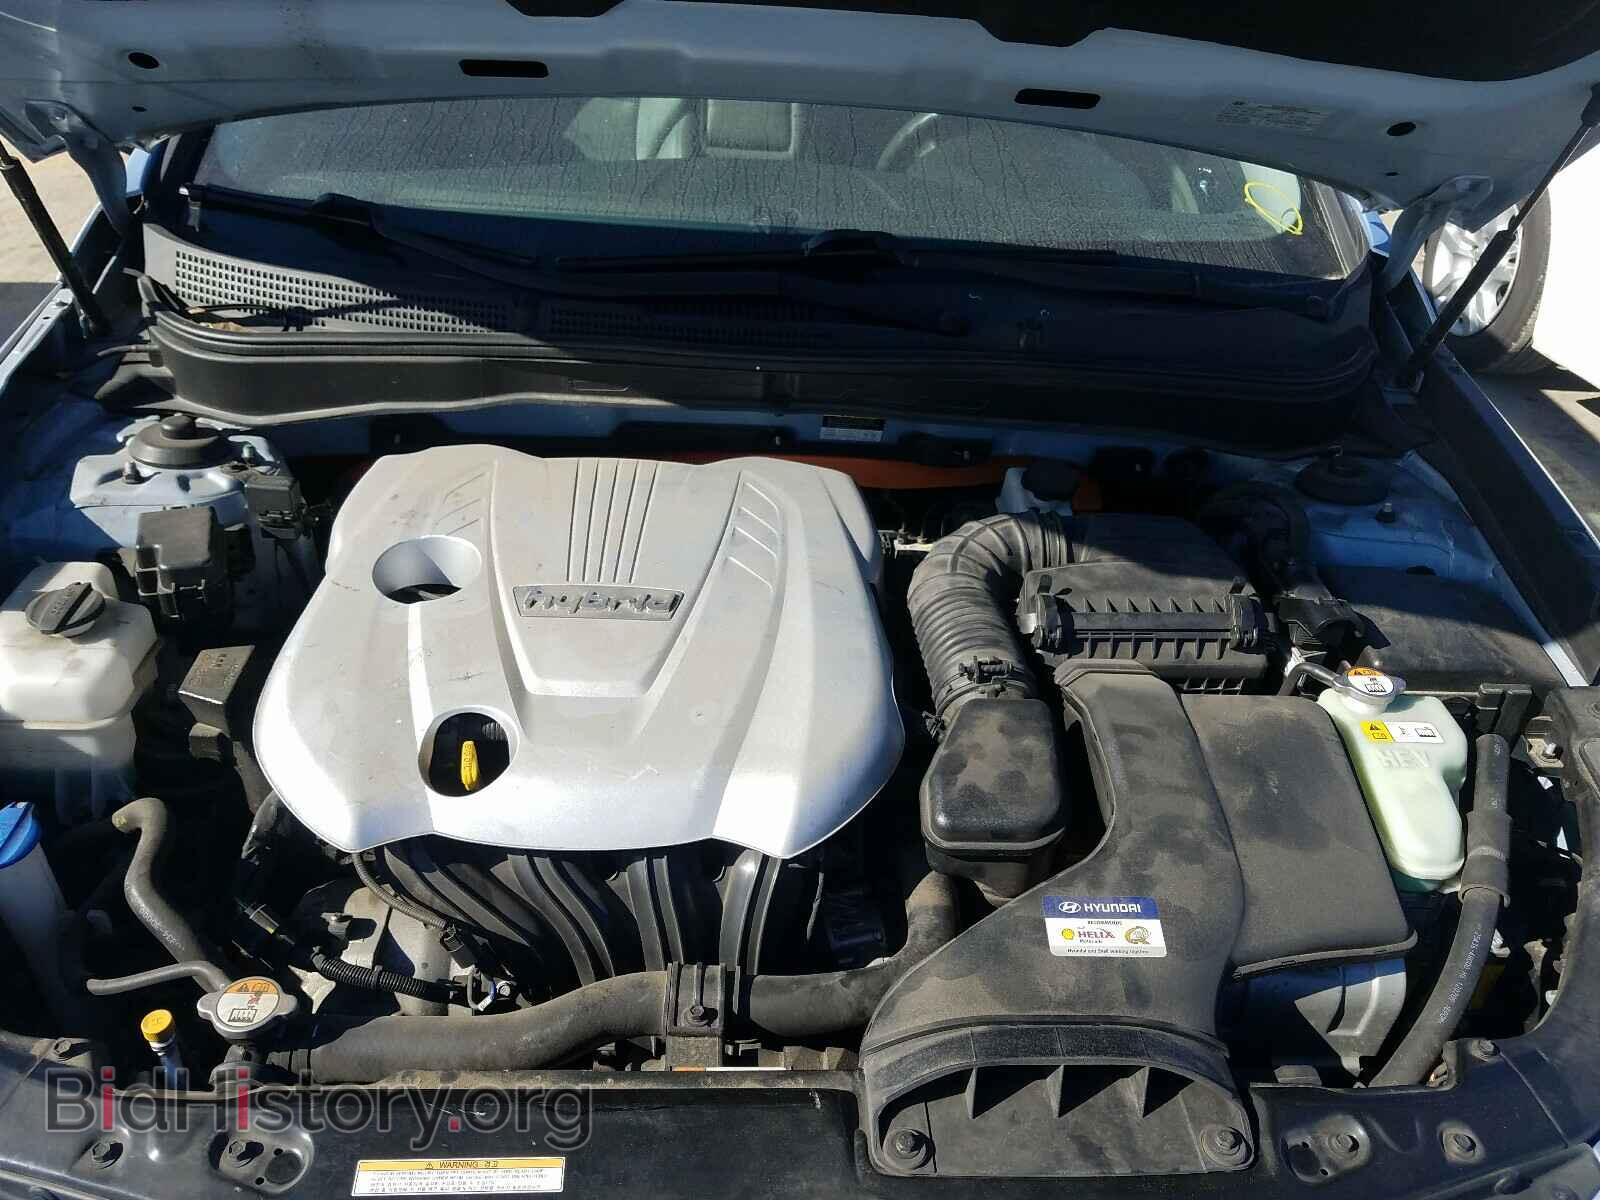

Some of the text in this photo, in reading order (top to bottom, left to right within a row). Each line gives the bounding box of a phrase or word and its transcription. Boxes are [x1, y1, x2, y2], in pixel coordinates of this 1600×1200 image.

[1084, 903, 1142, 913] HYUNDAI
[1078, 929, 1116, 938] HELIX
[440, 1161, 479, 1169] WARNING
